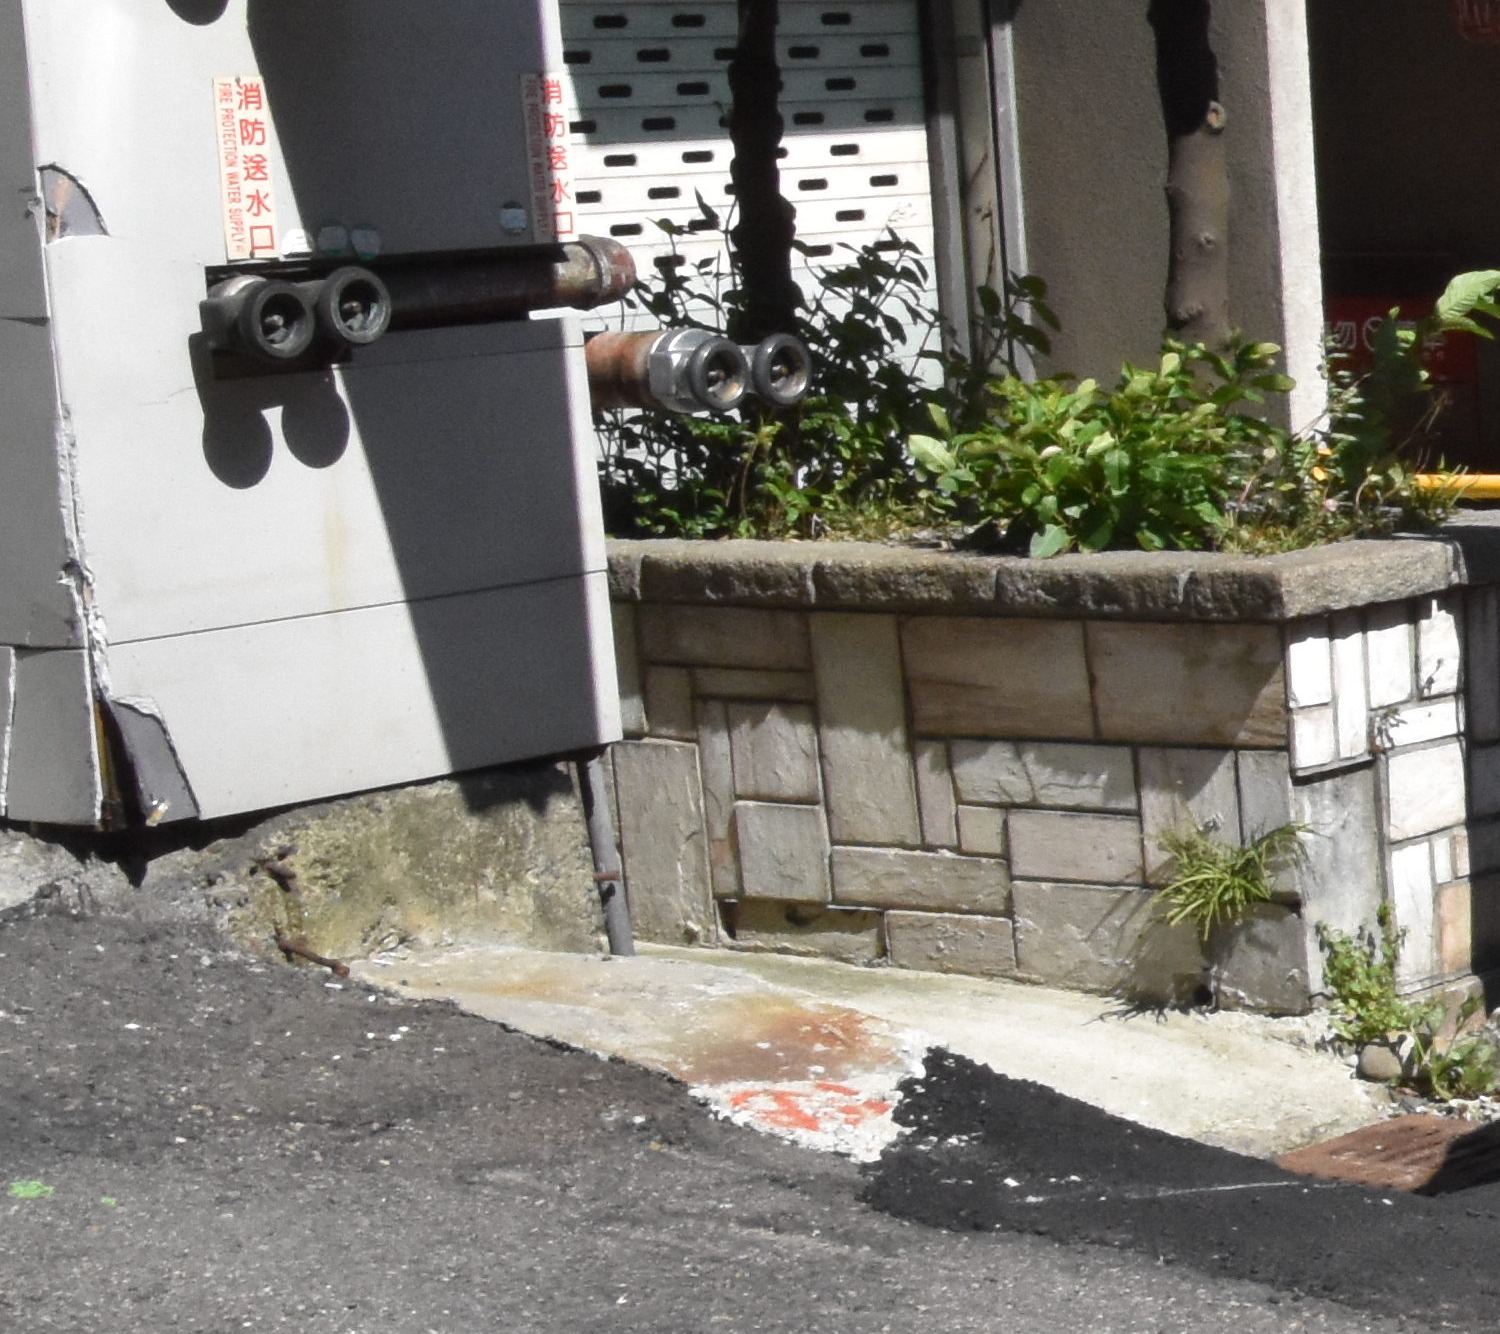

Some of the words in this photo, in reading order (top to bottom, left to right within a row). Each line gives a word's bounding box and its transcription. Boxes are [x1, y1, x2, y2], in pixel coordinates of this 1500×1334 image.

[219, 82, 233, 103] FIRE
[221, 107, 239, 167] PROTECTION
[540, 78, 574, 234] 消防送水口
[226, 171, 241, 203] WATER
[236, 82, 275, 251] 消防送水口
[227, 208, 245, 243] SUPPLY
